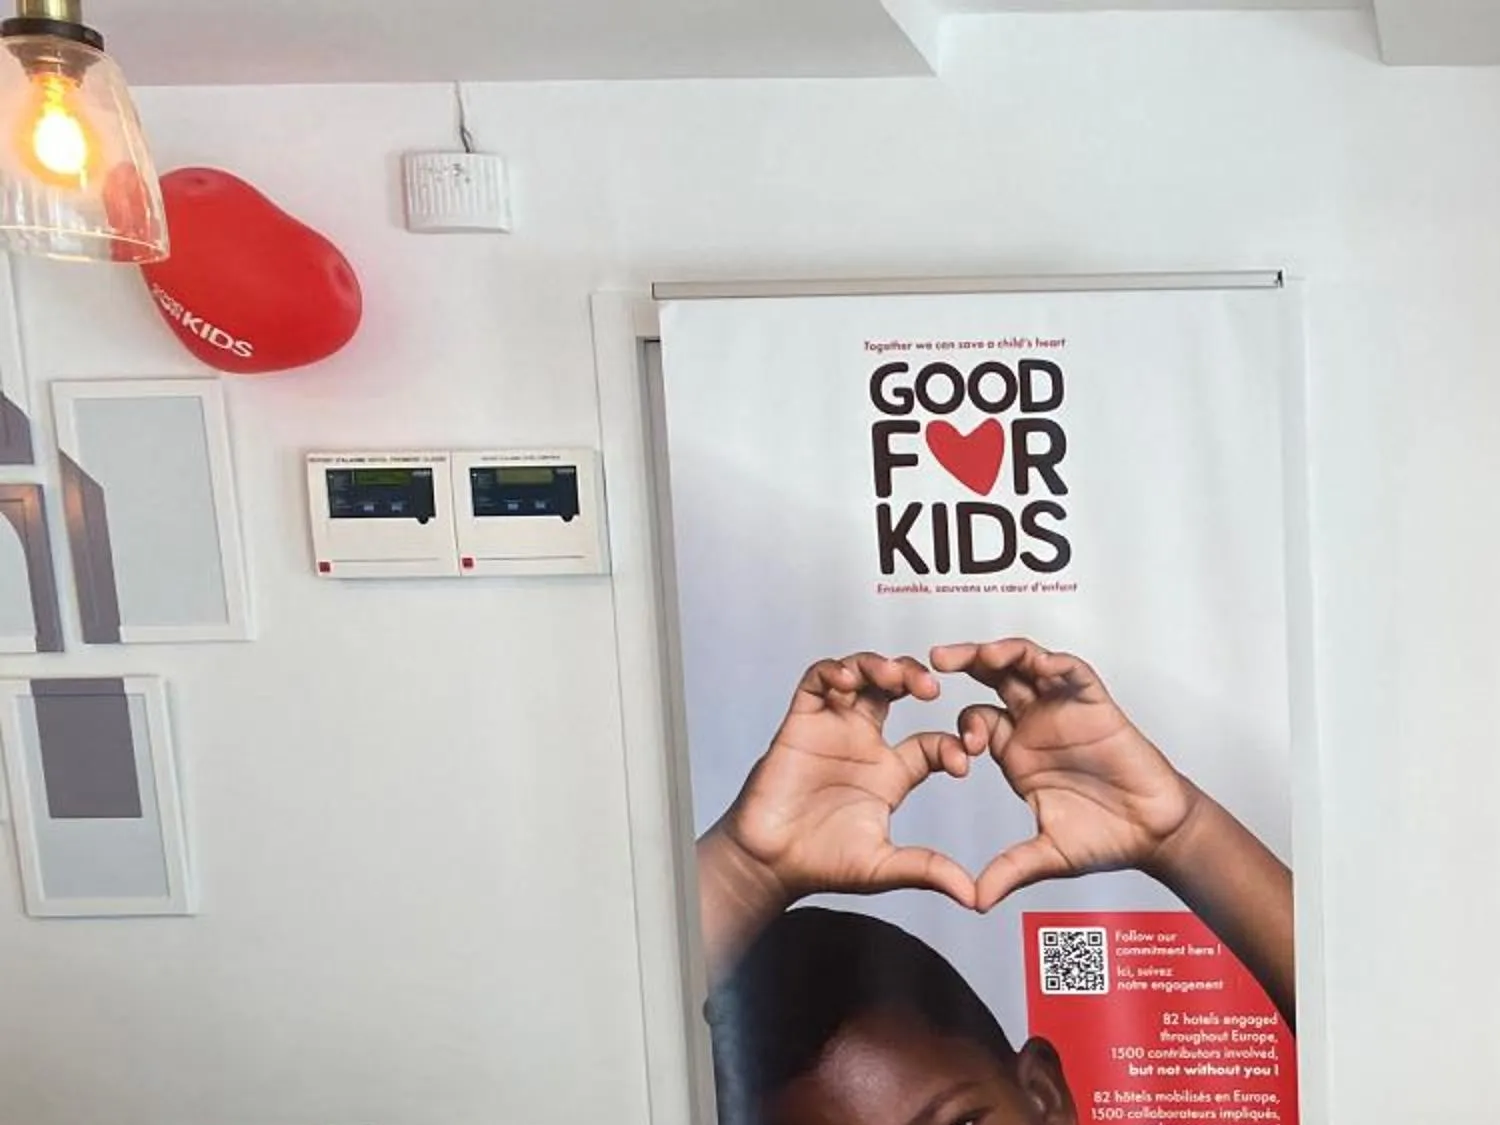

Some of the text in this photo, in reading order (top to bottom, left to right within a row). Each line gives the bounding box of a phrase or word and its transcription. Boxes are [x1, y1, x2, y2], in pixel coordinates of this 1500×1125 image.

[182, 311, 254, 358] KIDS
[864, 340, 912, 353] Together
[915, 342, 933, 351] we
[936, 341, 955, 351] can
[957, 340, 985, 350] save
[997, 337, 1033, 349] child's
[1035, 336, 1066, 348] heart
[869, 358, 1065, 416] GOOD
[875, 500, 1072, 575] KIDS
[935, 584, 981, 593] sauvons
[983, 584, 998, 593] un
[1031, 581, 1078, 593] d'enfant
[1115, 929, 1177, 942] Follow our
[1116, 945, 1186, 956] commitment
[1187, 943, 1214, 955] here
[1137, 965, 1174, 977] suivez
[1117, 979, 1224, 993] notre engagement
[1163, 1011, 1279, 1029] 82 hotels engaged
[1160, 1028, 1228, 1046] throughout
[1111, 1045, 1279, 1061] 1500 contributors involved,
[1129, 1063, 1153, 1076] but
[1157, 1064, 1180, 1076] not
[1184, 1062, 1241, 1076] without
[1244, 1065, 1271, 1080] you
[1093, 1089, 1281, 1105] 82 hôtels mobilisés en Europe,
[1091, 1105, 1281, 1121] 1500 collaborateurs impliqués,
